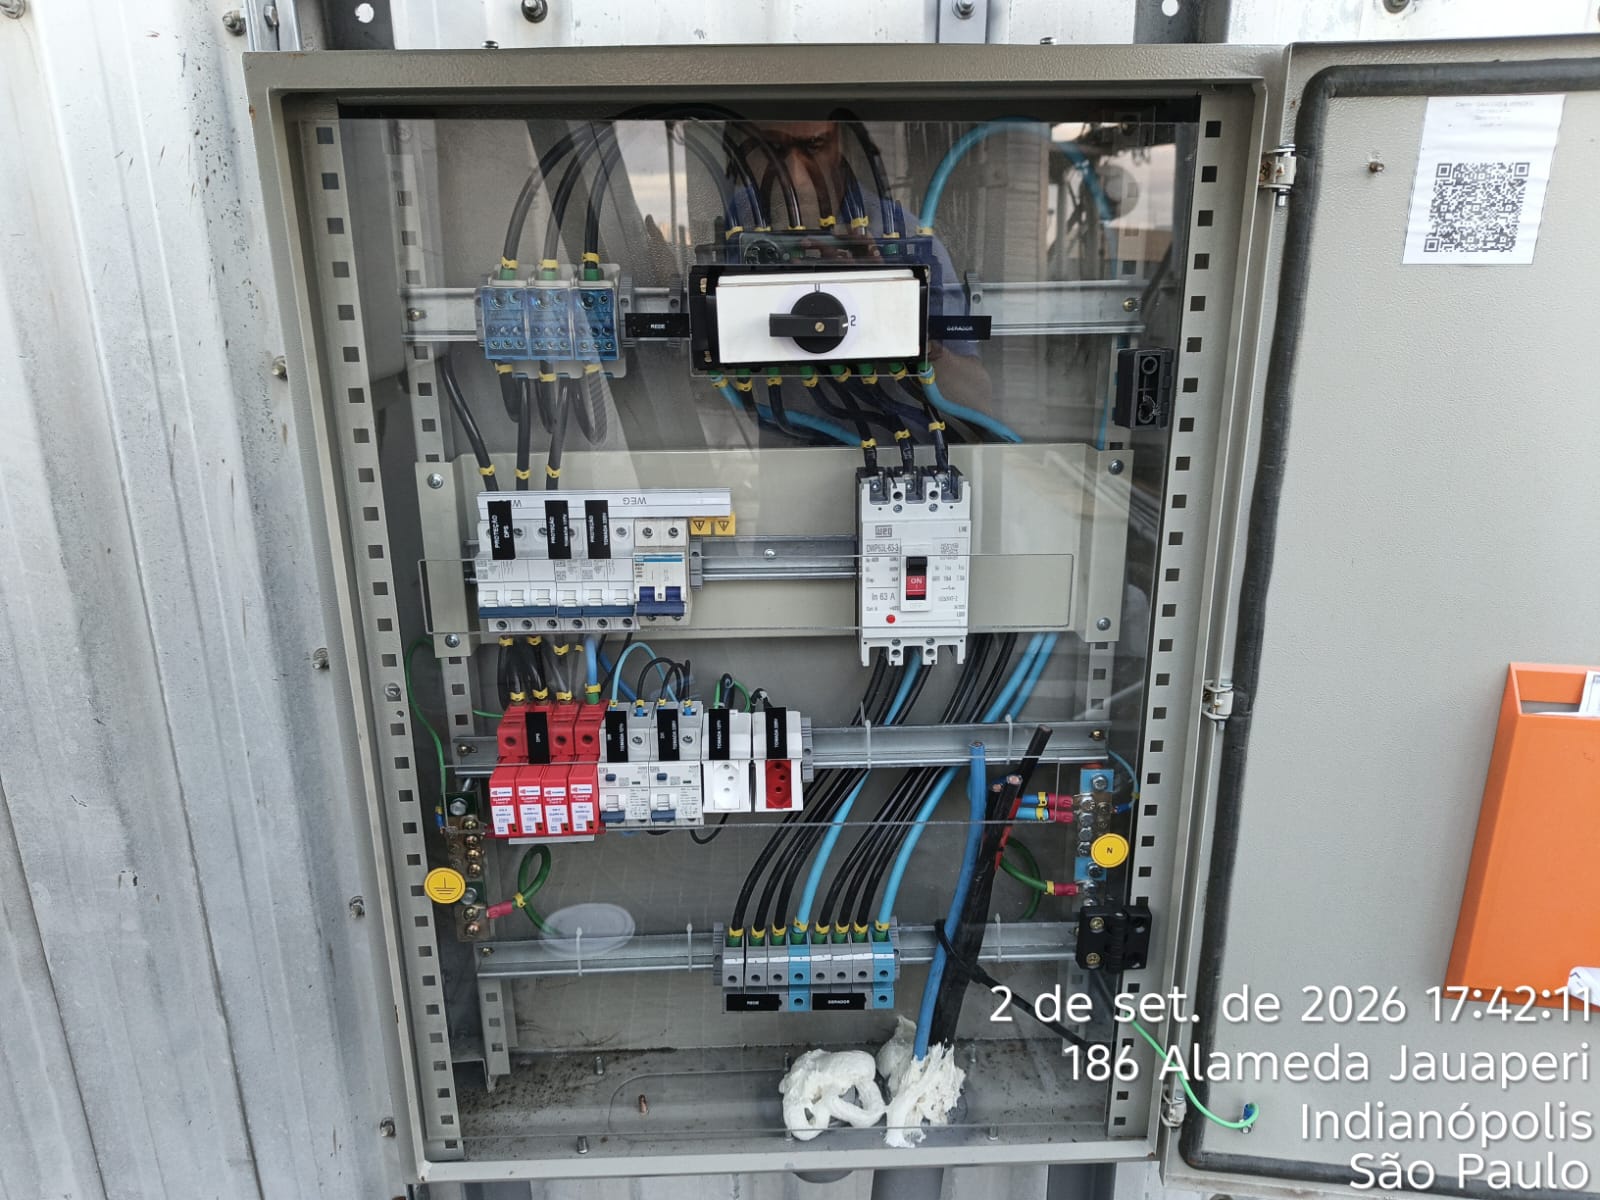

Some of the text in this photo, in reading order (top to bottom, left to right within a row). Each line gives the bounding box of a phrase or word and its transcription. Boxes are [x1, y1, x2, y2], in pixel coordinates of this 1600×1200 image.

[850, 314, 857, 327] 2
[622, 496, 647, 505] WEG
[491, 514, 501, 549] PROTEÇÃO
[879, 592, 888, 601] 63
[890, 592, 896, 601] A
